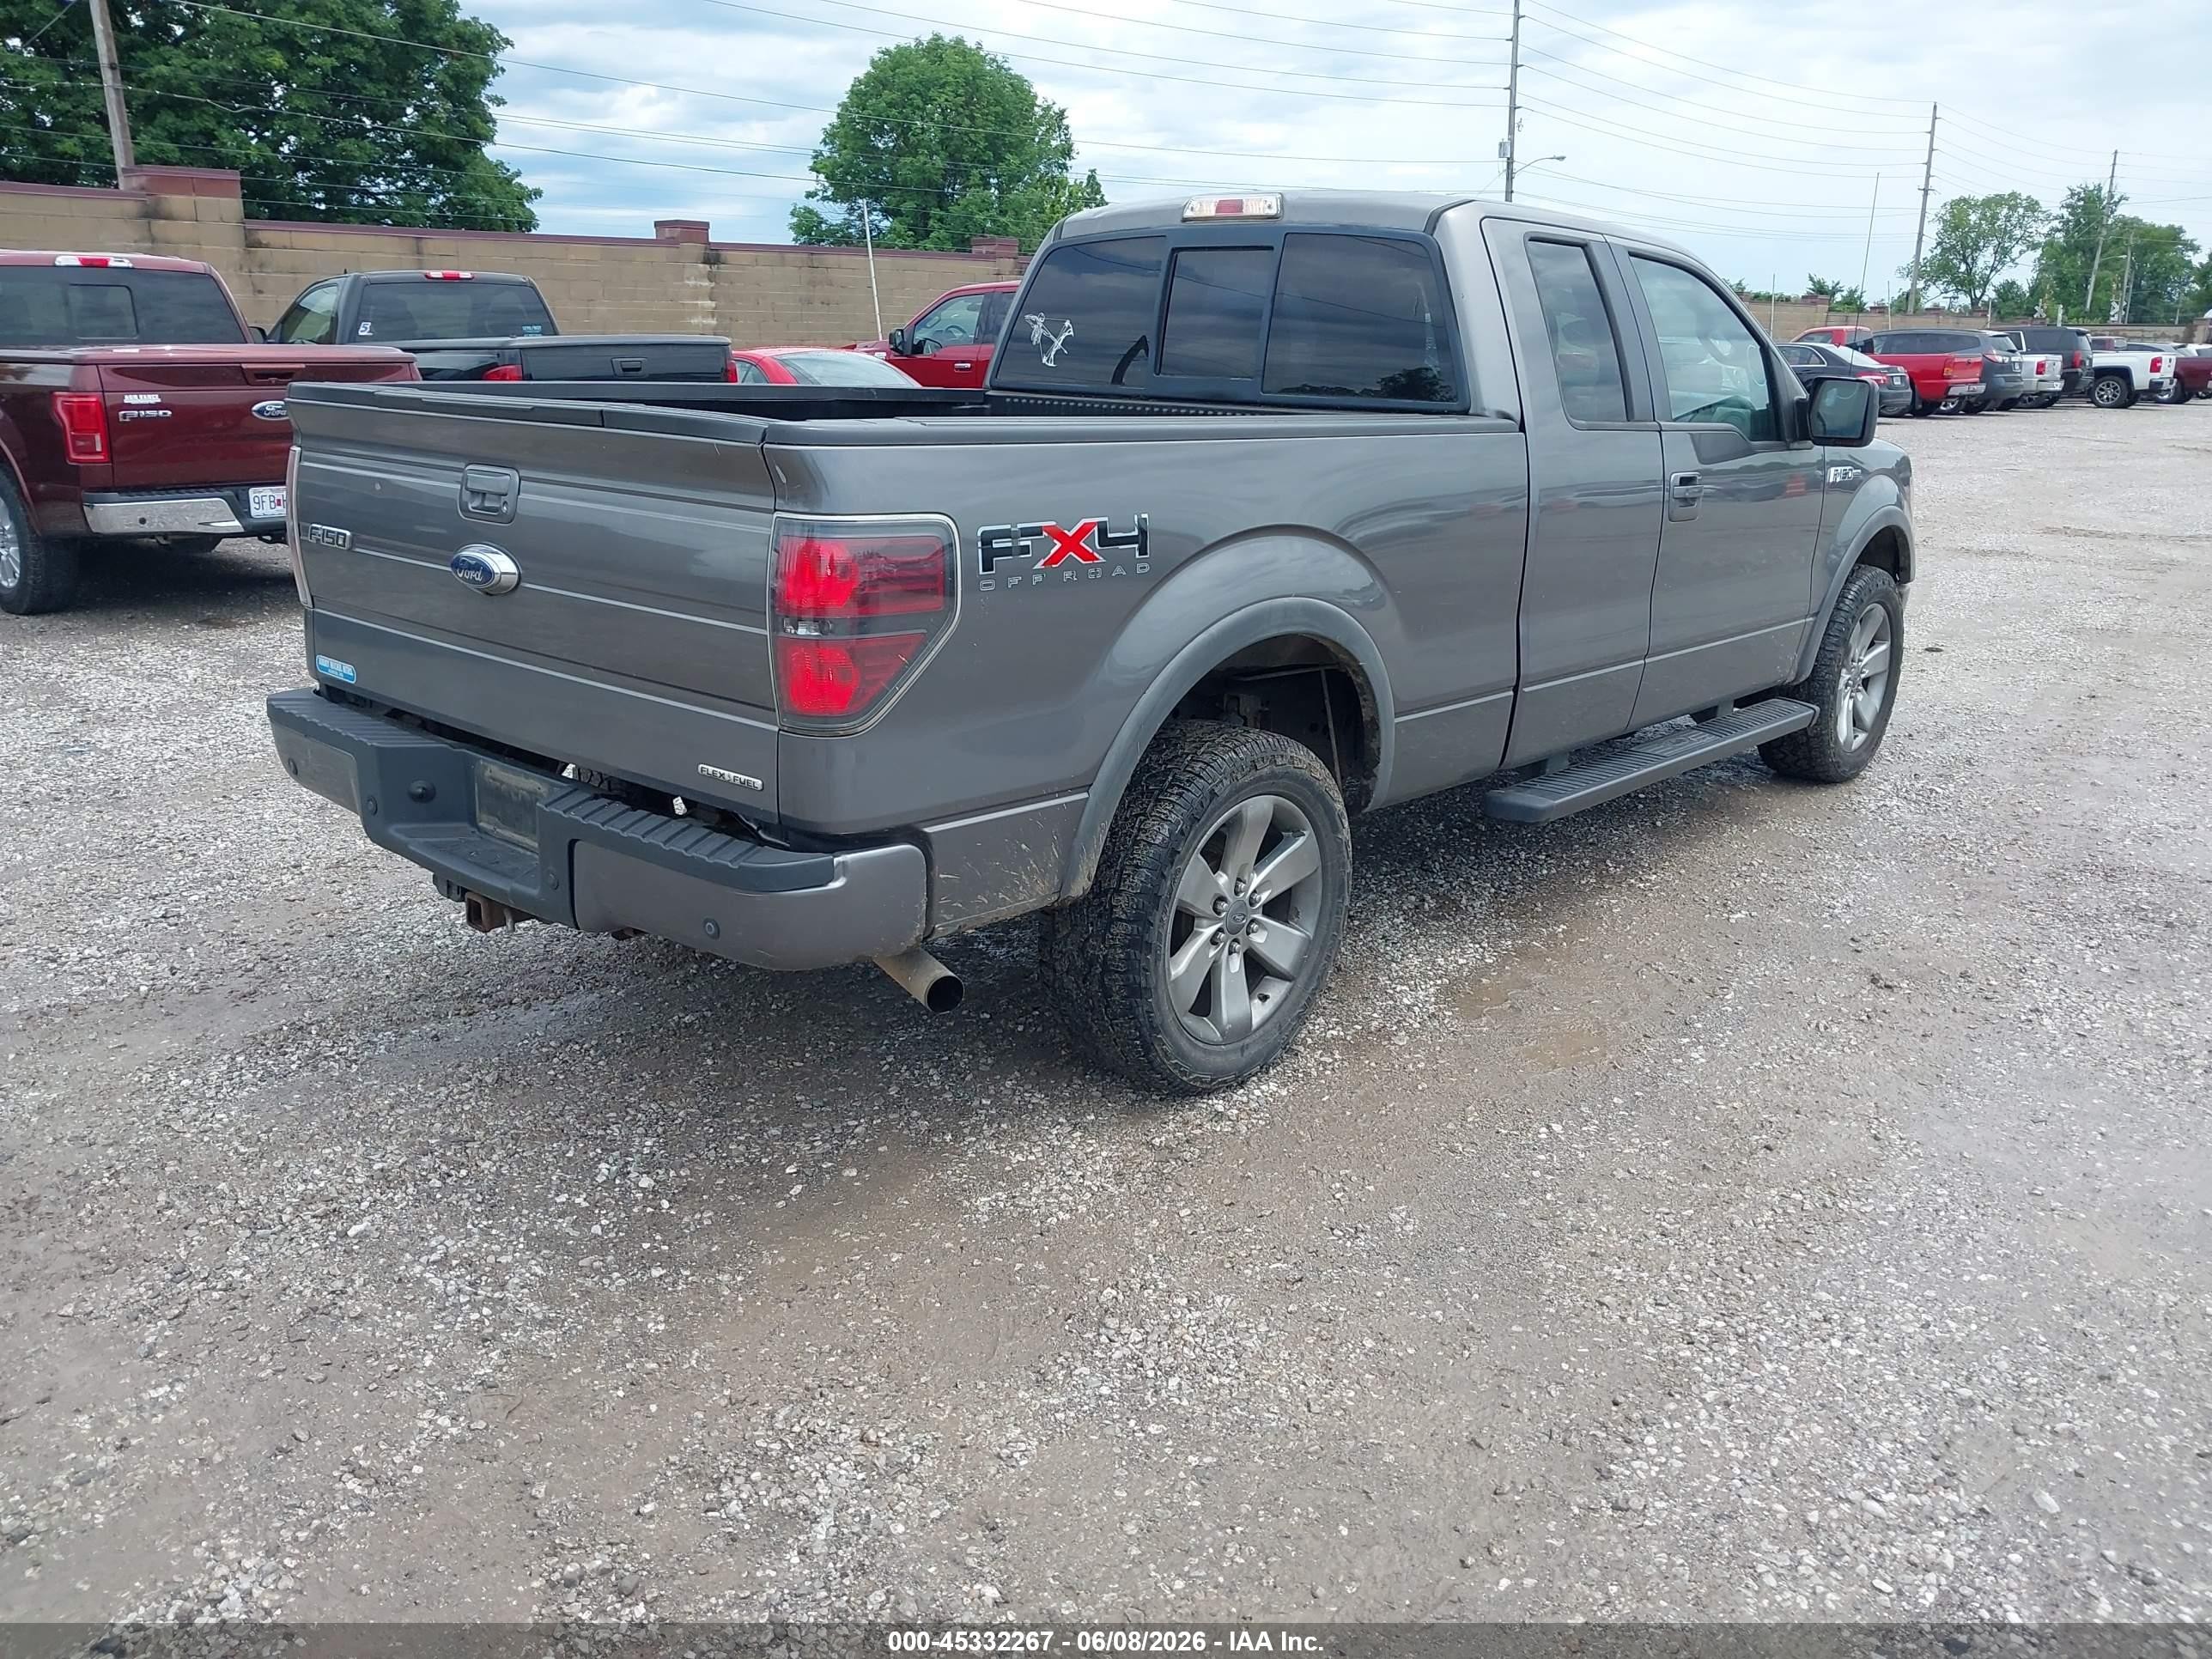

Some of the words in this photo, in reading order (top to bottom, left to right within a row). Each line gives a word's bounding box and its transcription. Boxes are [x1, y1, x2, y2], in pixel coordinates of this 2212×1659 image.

[977, 514, 1149, 574] FX4
[456, 556, 483, 582] Ford
[980, 573, 1046, 592] OFF
[1063, 562, 1151, 582] ROAD
